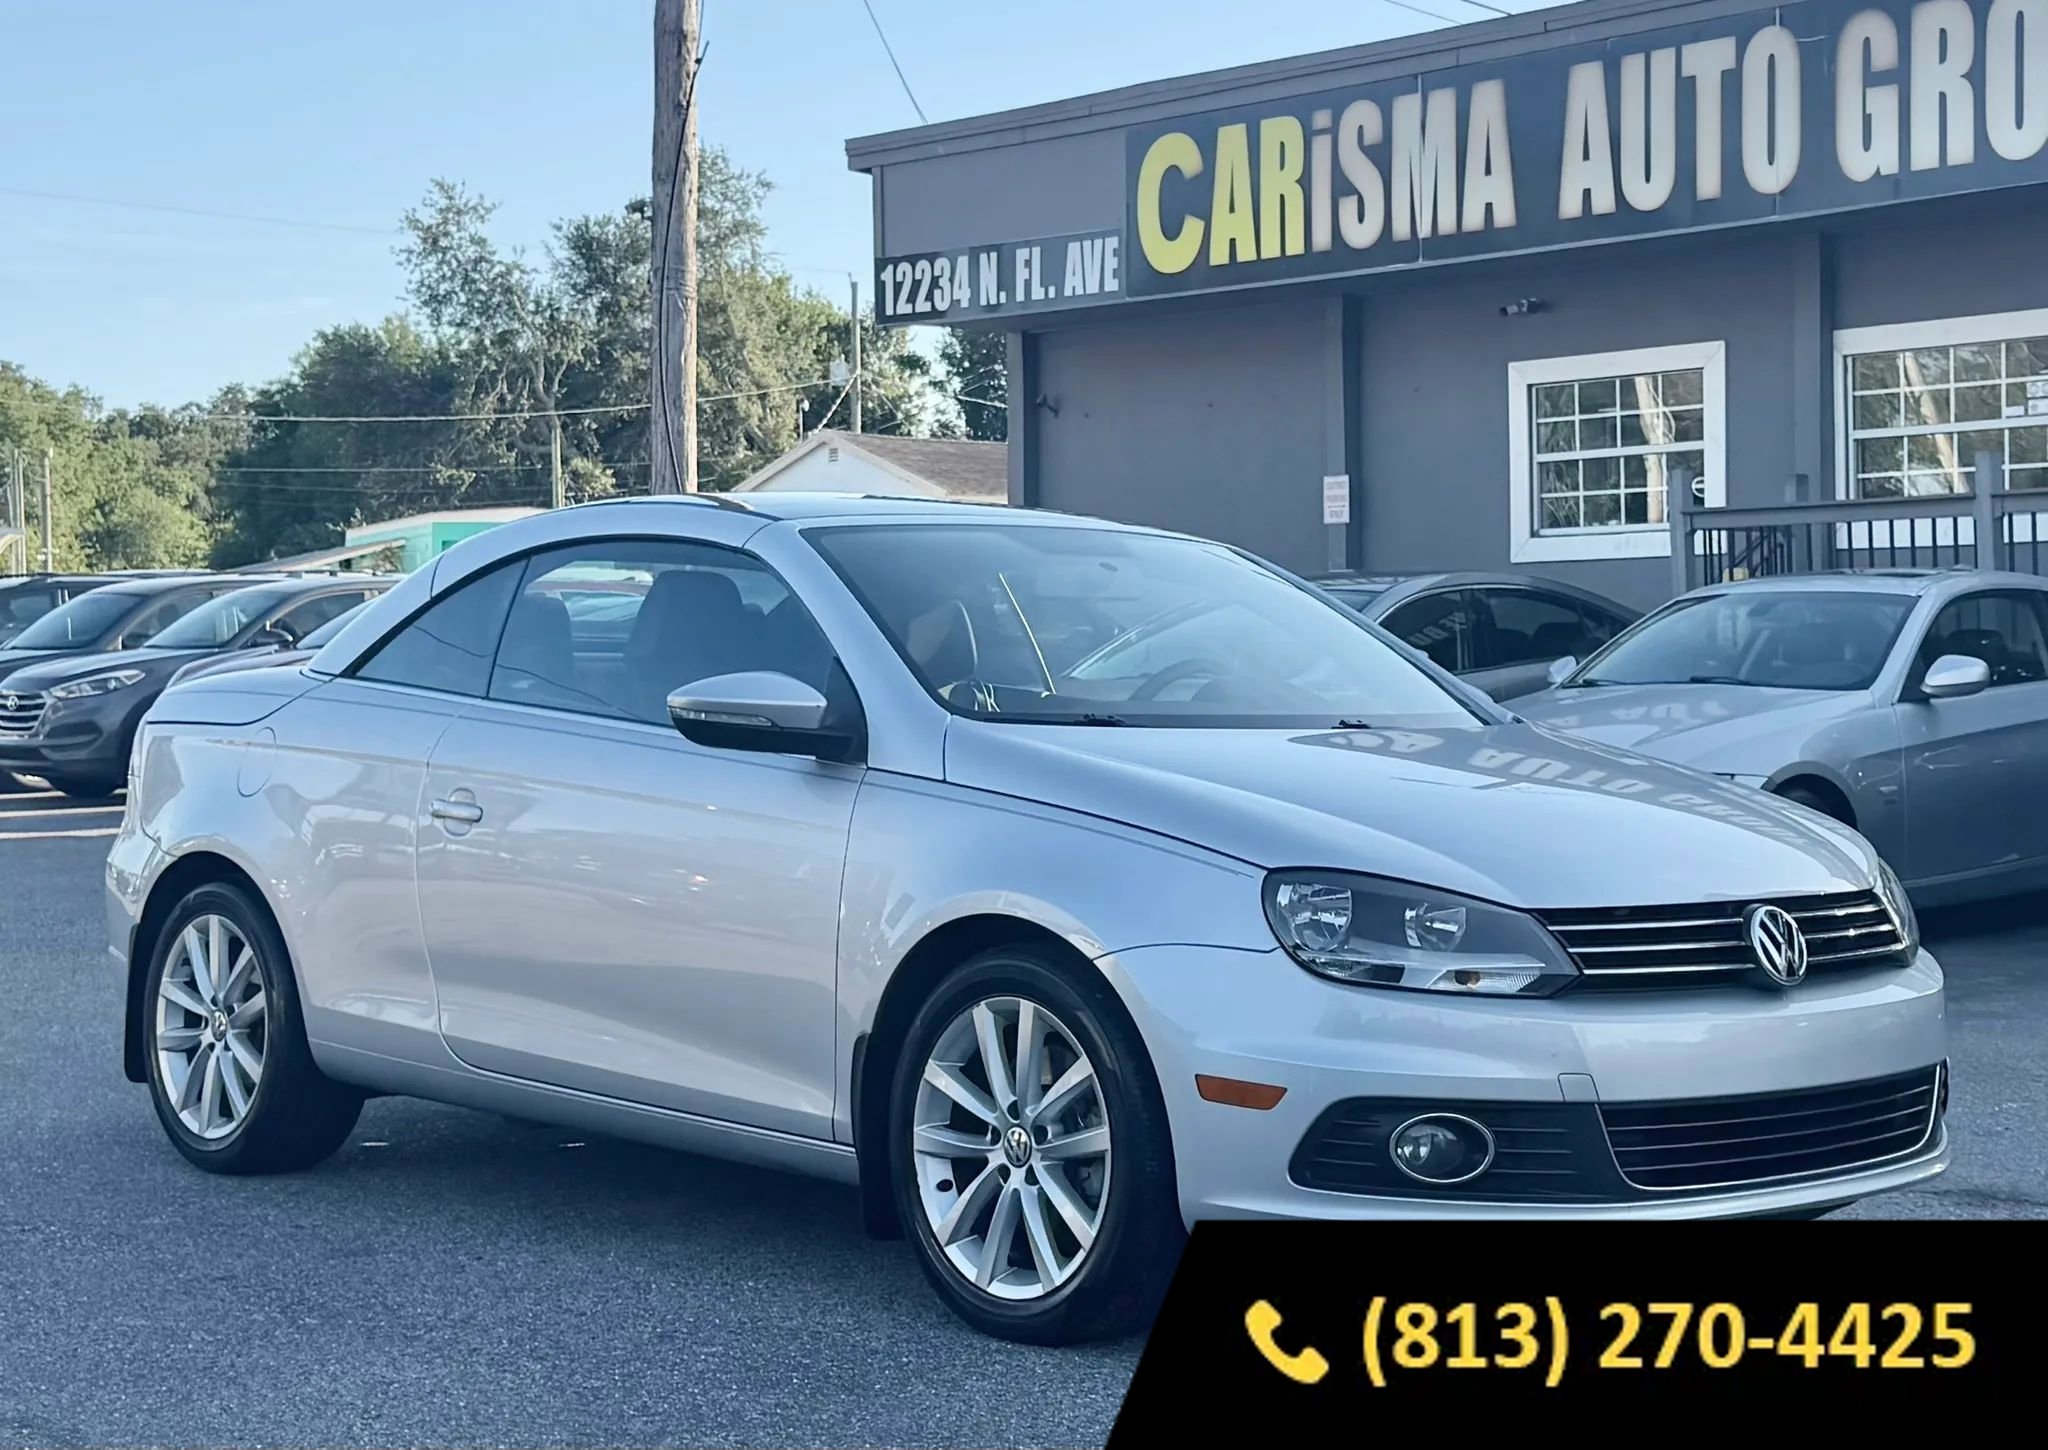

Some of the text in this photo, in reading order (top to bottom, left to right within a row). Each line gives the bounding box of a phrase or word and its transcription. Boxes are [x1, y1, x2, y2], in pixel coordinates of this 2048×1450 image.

[1136, 0, 2048, 274] CARiSMA AUTO GRO
[880, 236, 1120, 316] 12234 N. FL. AVE
